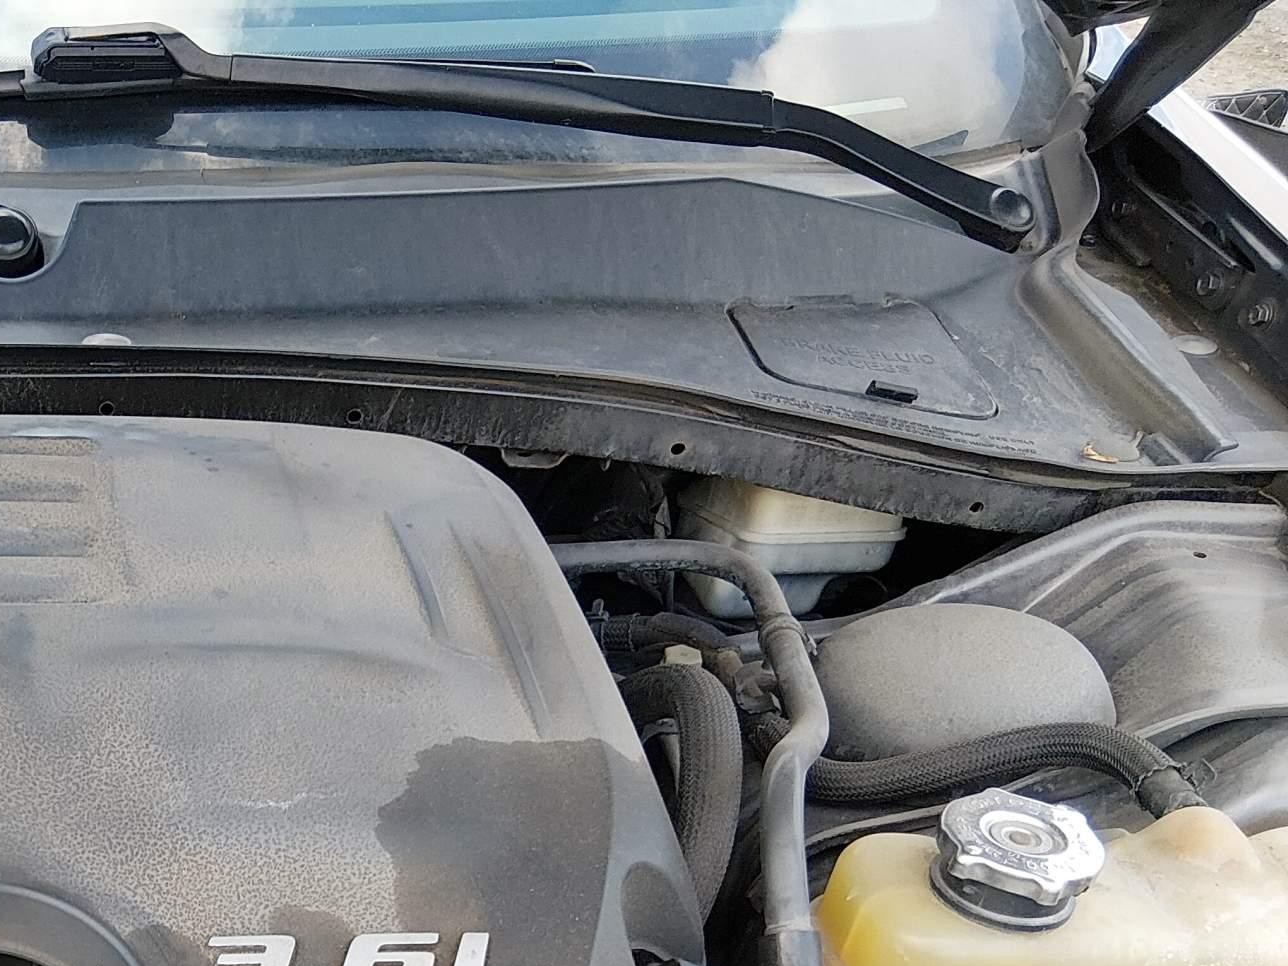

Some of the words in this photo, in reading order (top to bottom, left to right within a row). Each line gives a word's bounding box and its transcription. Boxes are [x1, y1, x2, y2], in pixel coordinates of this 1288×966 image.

[779, 338, 864, 358] BRAKE
[866, 349, 936, 365] FLUID
[817, 354, 911, 374] ACCESS
